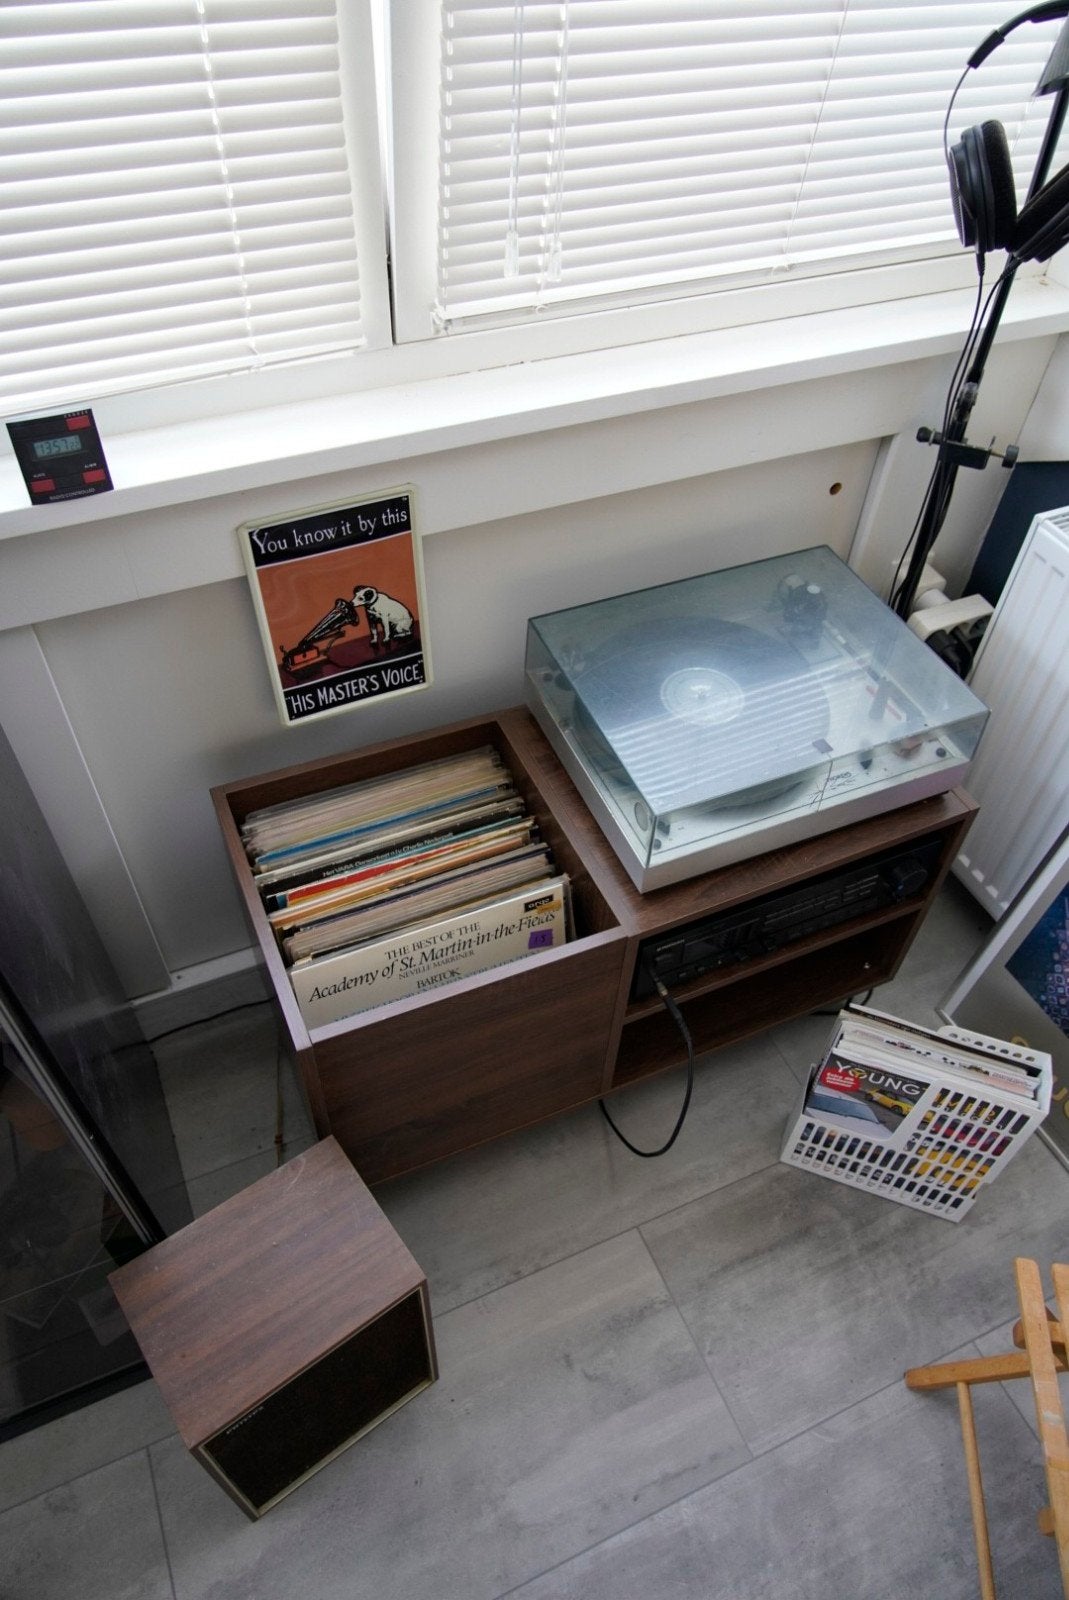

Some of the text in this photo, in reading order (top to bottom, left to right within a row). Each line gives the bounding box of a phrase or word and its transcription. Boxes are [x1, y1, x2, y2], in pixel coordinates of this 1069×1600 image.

[252, 507, 409, 555] You know it by this
[316, 674, 380, 707] MASTER'S
[384, 921, 480, 960] THE BEST OF THE
[309, 966, 379, 1003] Academy
[381, 959, 399, 979] of
[399, 955, 417, 972] St.
